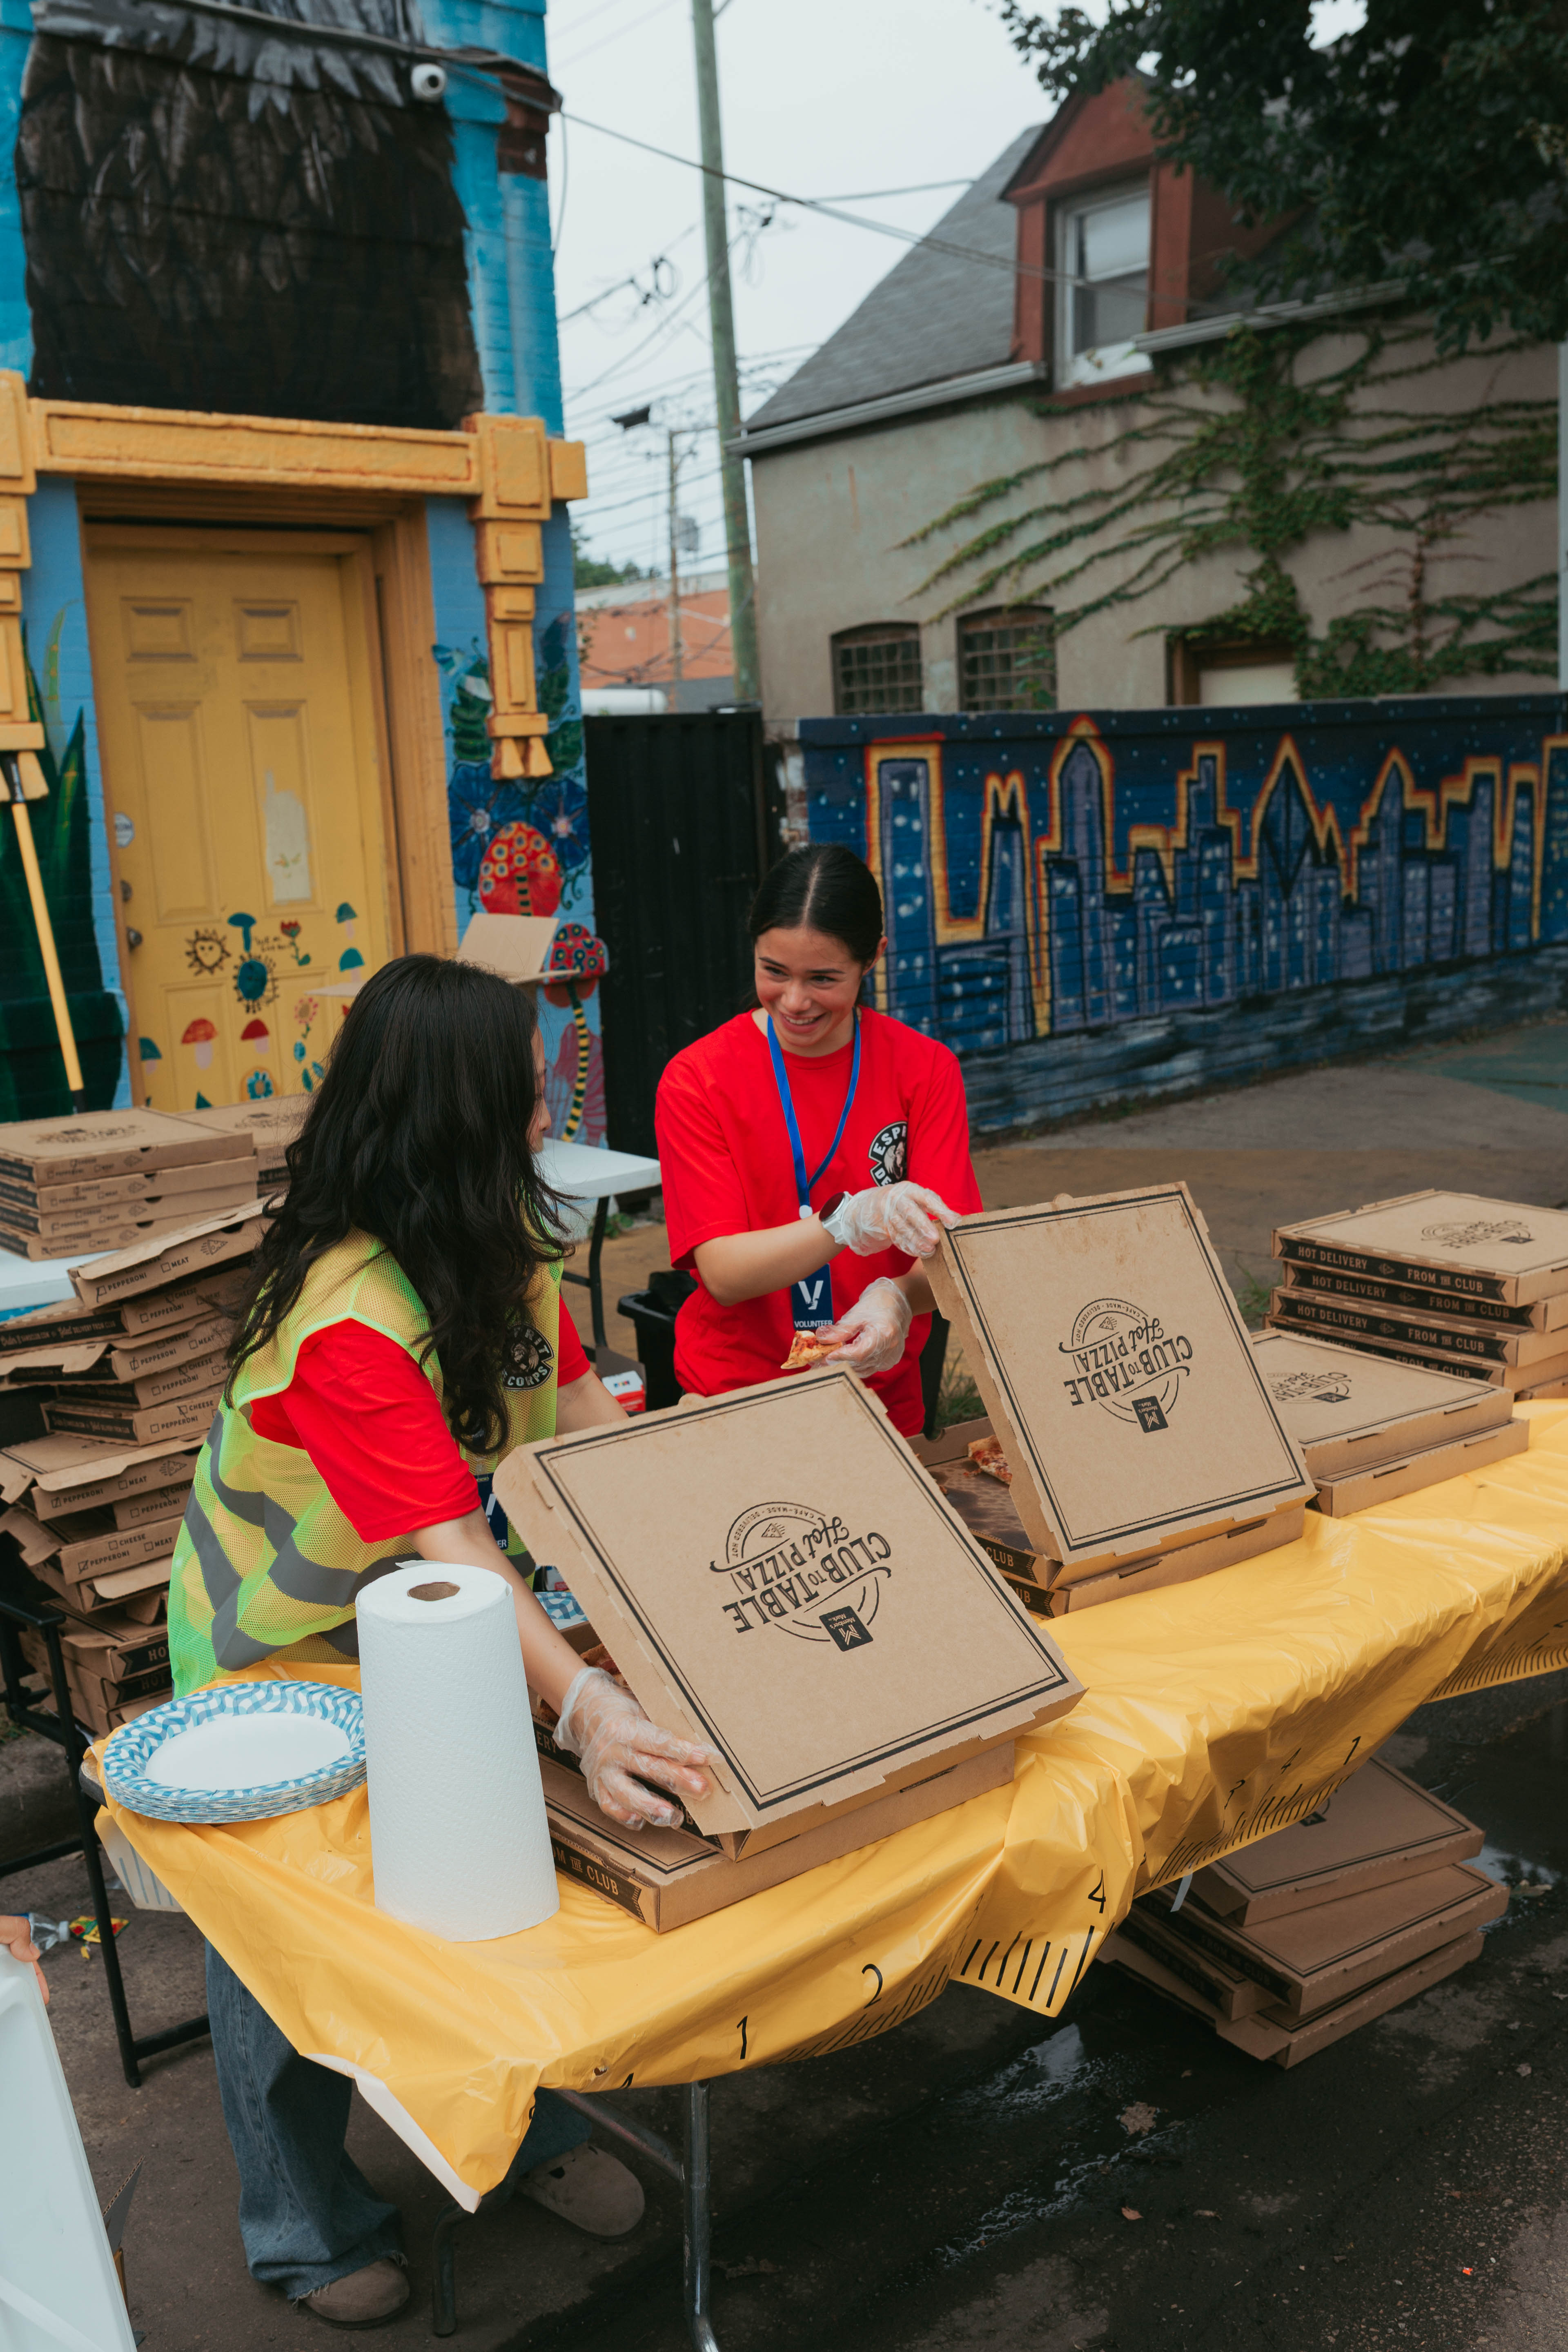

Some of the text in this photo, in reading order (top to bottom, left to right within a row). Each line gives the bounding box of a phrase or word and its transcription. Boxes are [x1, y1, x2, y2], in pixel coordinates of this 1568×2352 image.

[171, 1256, 189, 1268] MEAT
[1298, 1245, 1317, 1260] HOT
[1320, 1250, 1368, 1270] DELIVERY
[1407, 1268, 1436, 1284] FROM
[1455, 1277, 1483, 1293] CLUB
[107, 1272, 147, 1291] PEPPERONI
[174, 1287, 198, 1299] CHEESE
[1312, 1274, 1332, 1290] HOT
[1335, 1279, 1387, 1299] DELIVERY
[1429, 1296, 1460, 1312] FROM
[1480, 1304, 1510, 1319] CLUB
[149, 1304, 185, 1319] PEPPERONI
[1298, 1303, 1318, 1319] HOT
[1320, 1310, 1368, 1330] DELIVERY
[1408, 1327, 1437, 1344] FROM
[1456, 1337, 1485, 1353] CLUB
[1076, 1317, 1164, 1372] Hot PIZZA
[140, 1349, 177, 1365] PEPPERONI
[189, 1357, 213, 1371] CHEESE
[507, 1365, 548, 1386] CORPS
[1063, 1335, 1193, 1406] CLUB TO TABLE
[163, 1374, 199, 1391] PEPPERONI
[189, 1400, 214, 1411] CHEESE
[161, 1415, 198, 1429] PEPPERONI
[129, 1476, 147, 1486] MEAT
[63, 1489, 104, 1503] PEPPERONI
[141, 1498, 180, 1514] PEPPERONI
[119, 1533, 147, 1546] CHEESE
[154, 1537, 173, 1547] MEAT
[89, 1550, 130, 1566] PEPPERONI
[735, 1516, 849, 1592] Hot PIZZA
[722, 1532, 891, 1633] CLUB TO TABLE
[829, 1617, 856, 1630] Member's
[832, 1613, 847, 1622] Mark
[148, 1644, 169, 1662] HO
[587, 1865, 619, 1896] CLUB
[1087, 1869, 1106, 1914] 4
[862, 1963, 883, 2009] 2
[737, 2015, 748, 2060] 1
